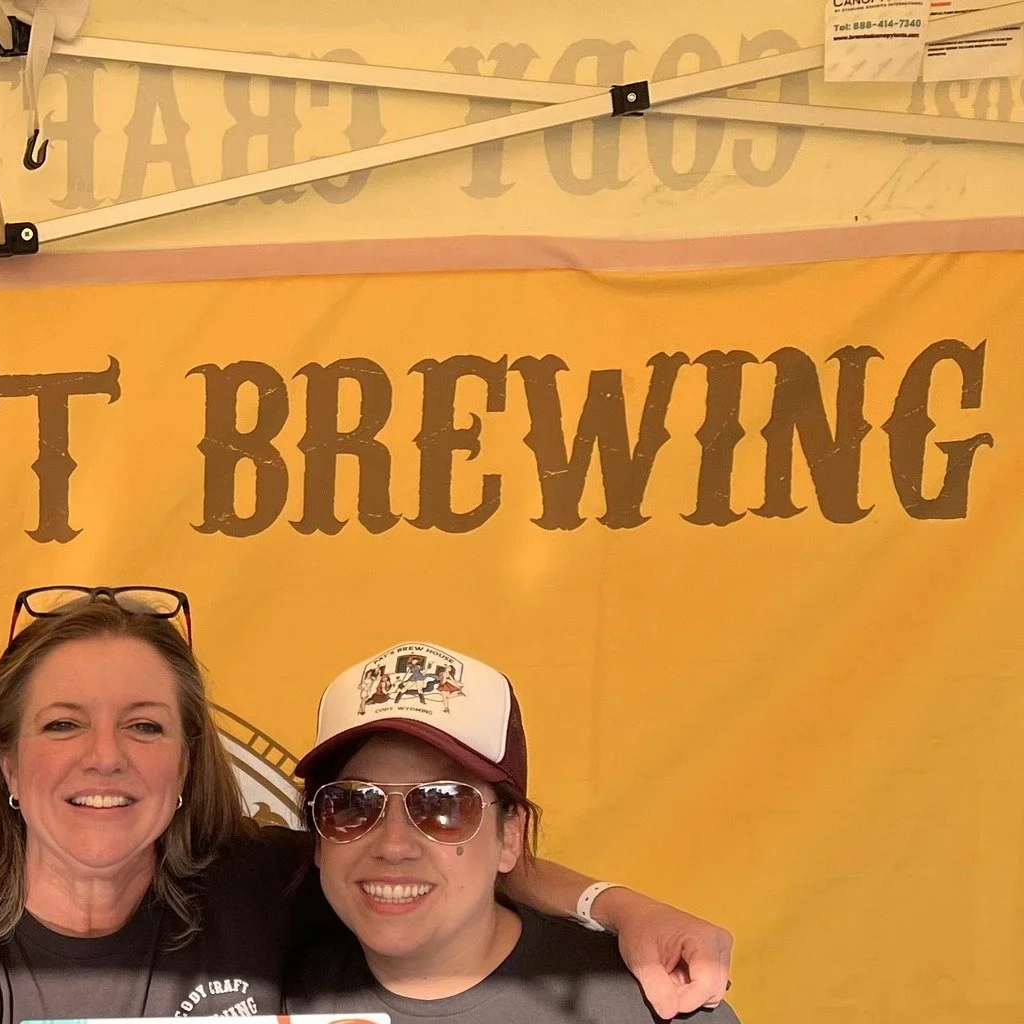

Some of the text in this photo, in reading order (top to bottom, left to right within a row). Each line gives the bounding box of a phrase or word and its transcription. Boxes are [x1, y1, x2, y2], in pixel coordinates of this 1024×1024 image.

[833, 19, 922, 31] Tel: 888-414-7340
[184, 338, 995, 537] BREWING
[426, 648, 455, 664] HOUSE
[397, 706, 433, 715] WYOMING
[208, 978, 250, 995] CRAFT
